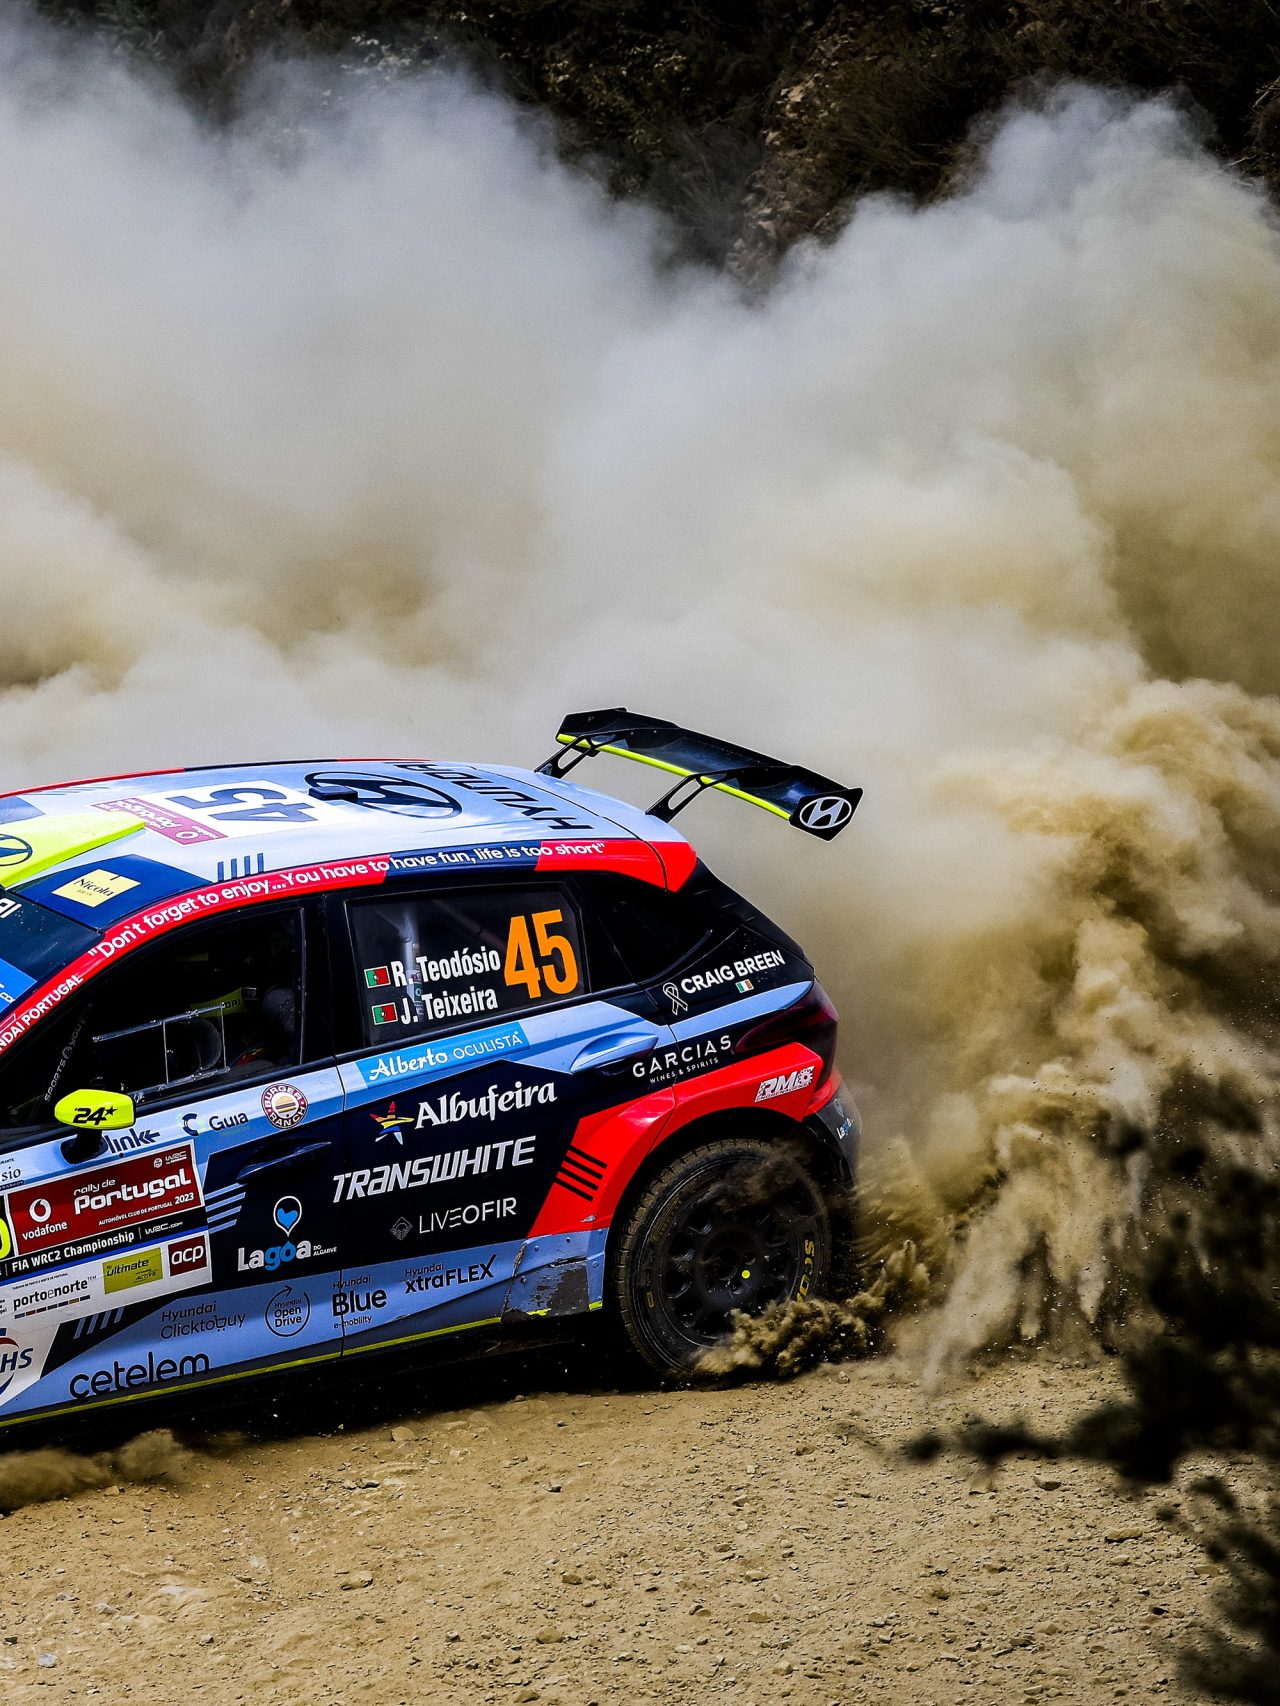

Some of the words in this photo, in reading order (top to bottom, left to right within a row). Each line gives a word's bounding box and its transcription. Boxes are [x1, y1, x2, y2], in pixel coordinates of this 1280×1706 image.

[165, 787, 318, 823] 45
[73, 878, 114, 897] Nicola
[143, 900, 200, 929] forget
[197, 892, 220, 907] to
[320, 863, 366, 880] have
[369, 858, 391, 873] to
[390, 853, 439, 870] have
[438, 850, 477, 864] fun,
[474, 846, 504, 860] life
[507, 844, 521, 857] is
[521, 844, 553, 857] too
[390, 960, 414, 987] R.
[416, 946, 501, 983] Teodósio
[503, 909, 579, 998] 45
[680, 965, 736, 994] CRAIG
[733, 949, 786, 977] BREEN
[21, 974, 84, 1026] PORTUGAL
[400, 997, 418, 1025] J.
[421, 985, 499, 1021] Teixeira
[368, 1047, 449, 1081] Alberto
[452, 1030, 525, 1061] OCULISTA
[632, 1034, 732, 1078] GARCIAS
[649, 1071, 677, 1085] WINES
[686, 1057, 719, 1073] SPIRITS
[264, 1084, 302, 1108] BURGER
[414, 1081, 558, 1131] Albufeira
[208, 1112, 249, 1131] Guia
[269, 1107, 306, 1128] RANCH
[332, 1135, 537, 1204] TRANSWHITE
[73, 1183, 100, 1196] rally
[101, 1179, 116, 1188] de
[74, 1168, 192, 1215] Portugal
[174, 1192, 195, 1205] 2023
[419, 1197, 518, 1234] LIVEOFIR
[21, 1220, 68, 1241] vodafone
[11, 1260, 30, 1273] FIA
[30, 1250, 62, 1267] WRC2
[63, 1230, 135, 1257] Championship
[171, 1245, 204, 1265] acp
[237, 1240, 312, 1271] Lagoa
[312, 1246, 338, 1257] ALGARVE
[106, 1258, 150, 1277] ultimate
[332, 1274, 371, 1290] Hyundai
[404, 1262, 444, 1278] Hyundai
[161, 1301, 217, 1323] Hyundai
[274, 1298, 302, 1309] Hyundai
[274, 1306, 302, 1319] Open
[332, 1287, 387, 1317] Blue
[274, 1315, 302, 1328] Drive
[70, 1351, 210, 1400] cetelem
